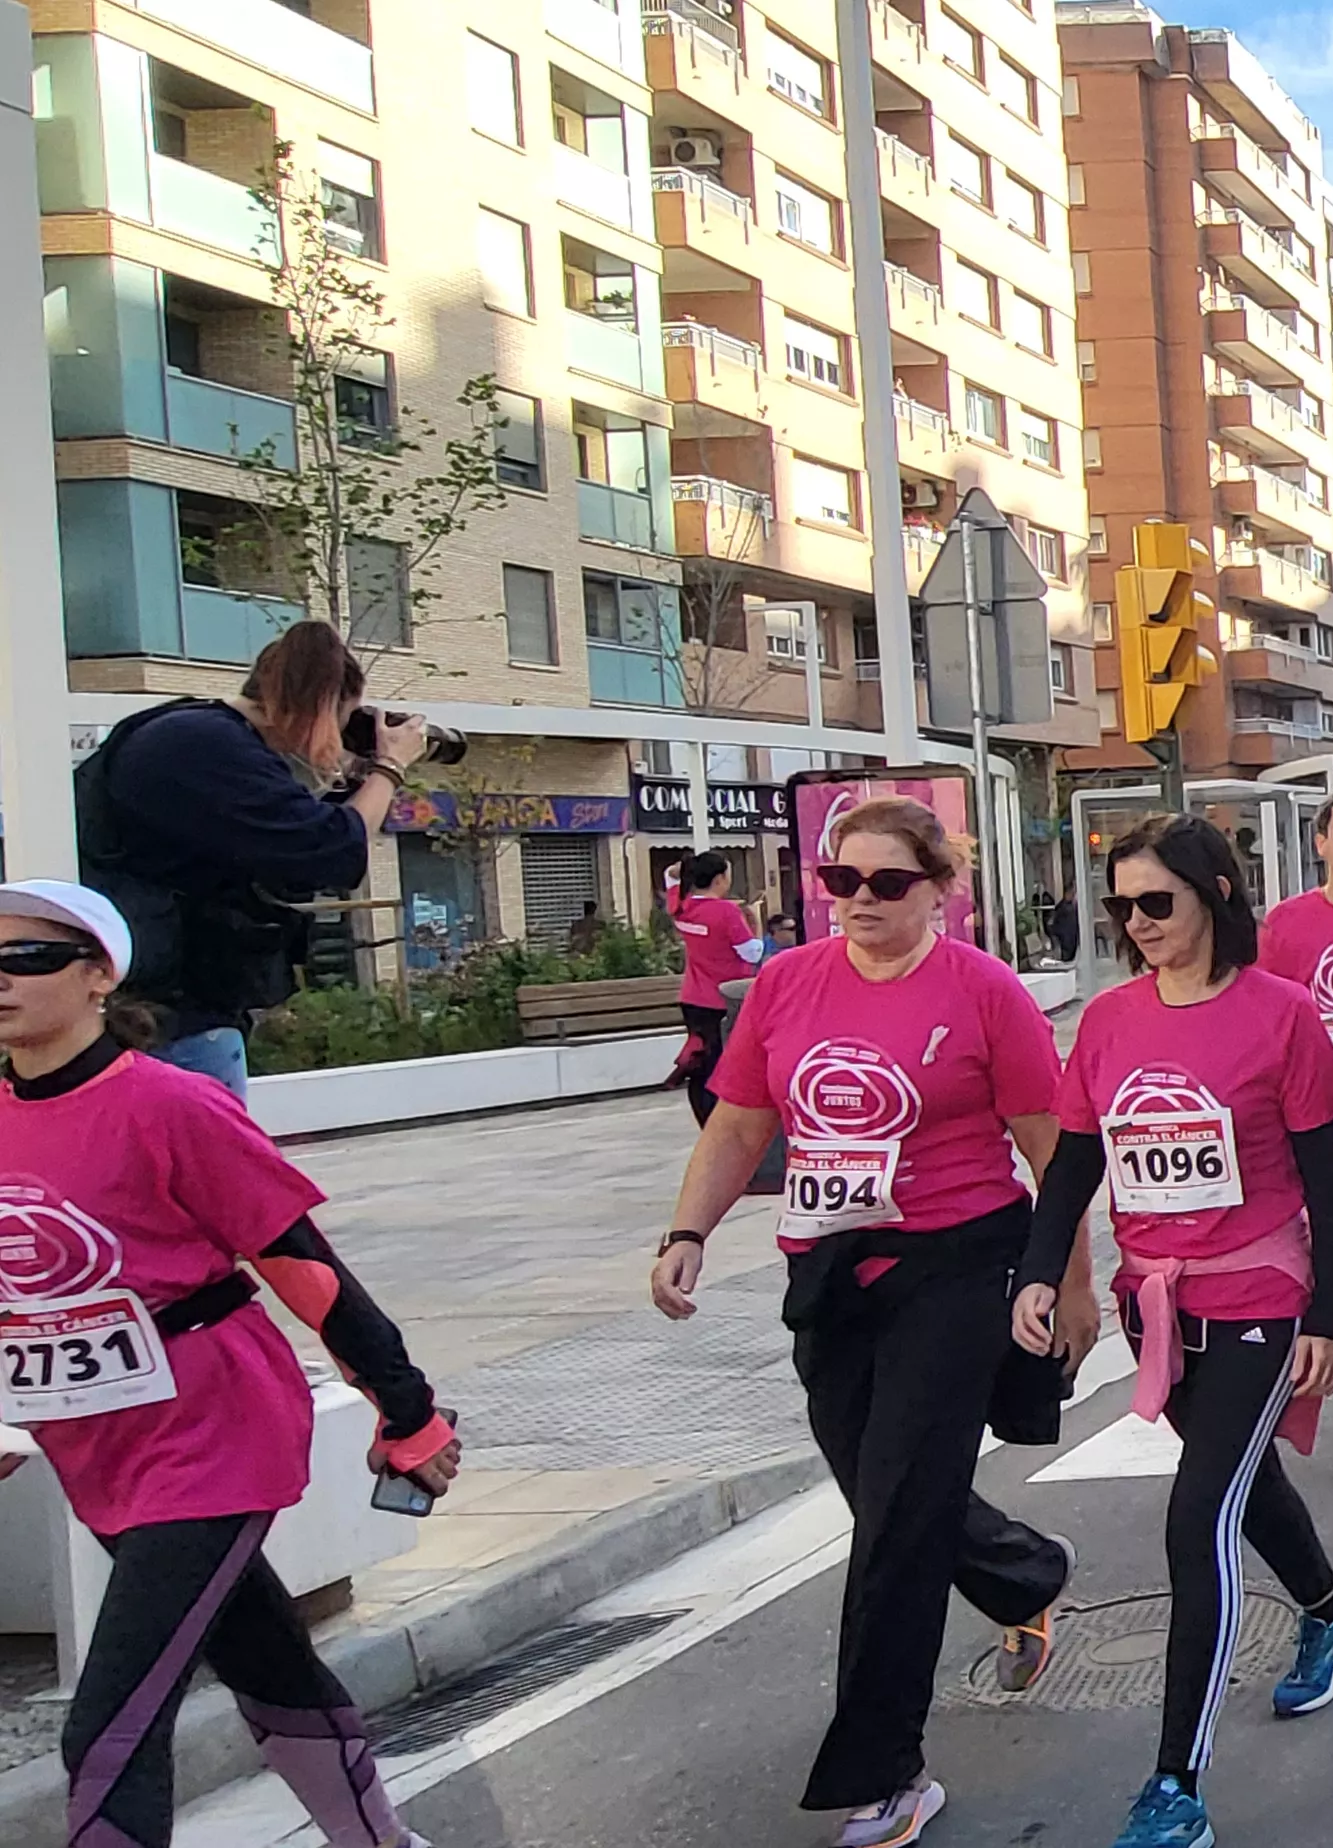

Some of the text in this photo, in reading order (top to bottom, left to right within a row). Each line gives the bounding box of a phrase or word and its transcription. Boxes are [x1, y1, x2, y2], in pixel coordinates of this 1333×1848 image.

[639, 785, 760, 813] COMRCIAL
[1121, 1145, 1224, 1183] 1096
[788, 1174, 878, 1212] 1094
[4, 1329, 140, 1387] 2731
